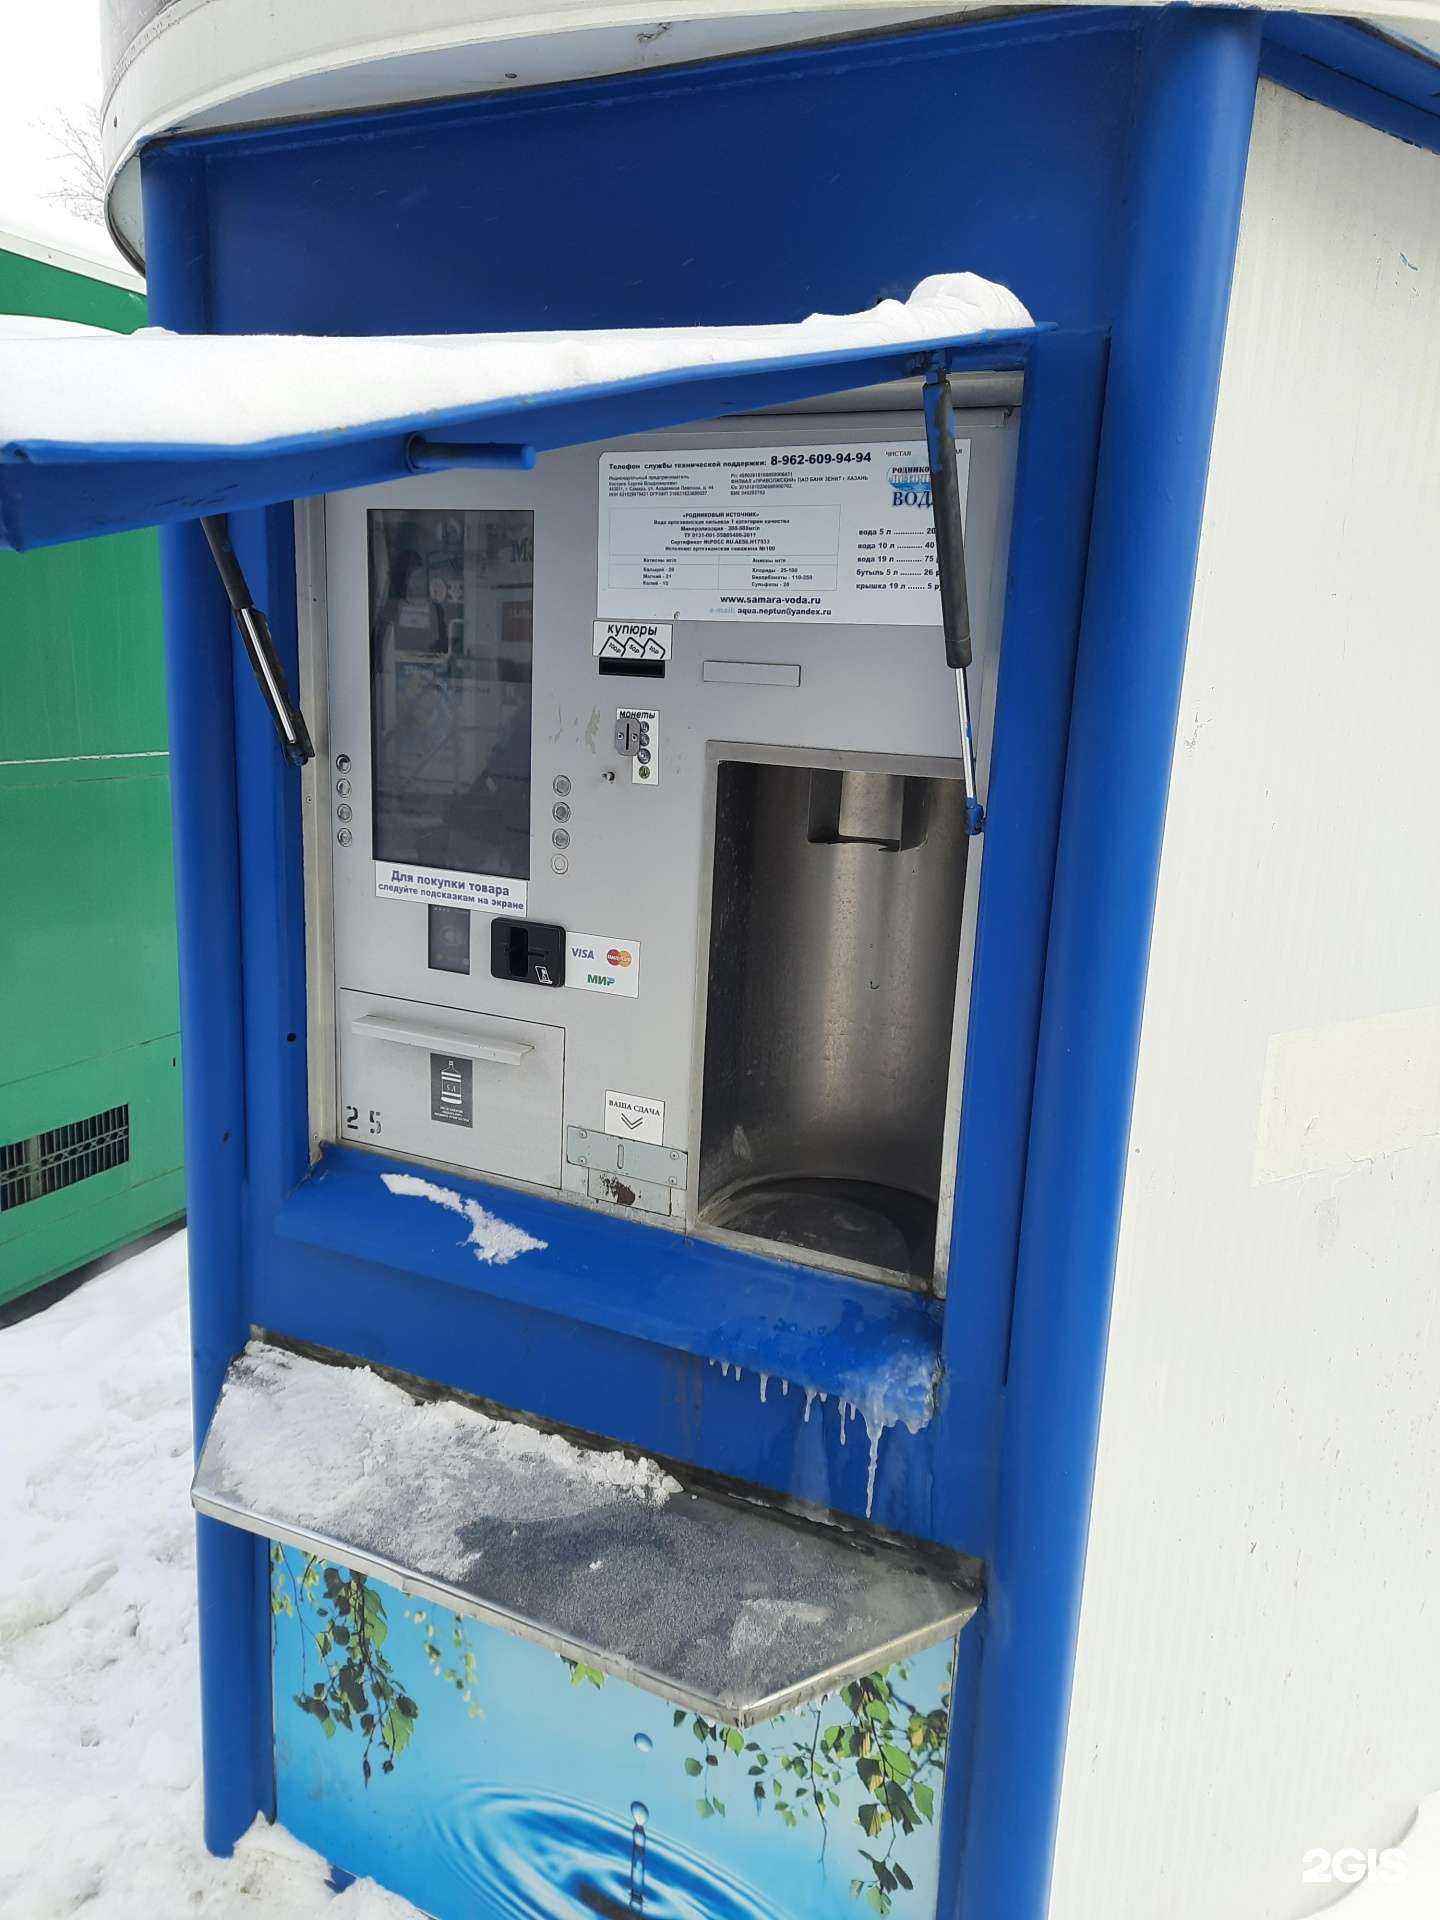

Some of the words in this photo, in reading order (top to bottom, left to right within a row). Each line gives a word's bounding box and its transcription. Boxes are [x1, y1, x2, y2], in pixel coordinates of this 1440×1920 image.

[674, 460, 720, 468] технической
[770, 452, 872, 466] 8-962-609-94-94
[892, 466, 930, 474] РОДНИКО
[892, 491, 932, 508] ВОД
[924, 541, 935, 549] 40
[856, 568, 884, 577] бутыль
[923, 568, 934, 576] 26
[856, 583, 887, 591] крышка
[720, 595, 821, 605] www.samara-voda.ru
[608, 624, 657, 637] купюры
[619, 711, 656, 719] монеты
[391, 870, 414, 883] Для
[417, 876, 466, 890] покупки
[468, 882, 510, 897] товара
[378, 882, 418, 894] следуйте
[420, 888, 475, 902] подсказкам
[477, 897, 489, 905] на
[491, 900, 524, 910] экране
[571, 947, 595, 960] VISA
[608, 1099, 632, 1111] ВАША
[633, 1104, 661, 1117] СДАЧА
